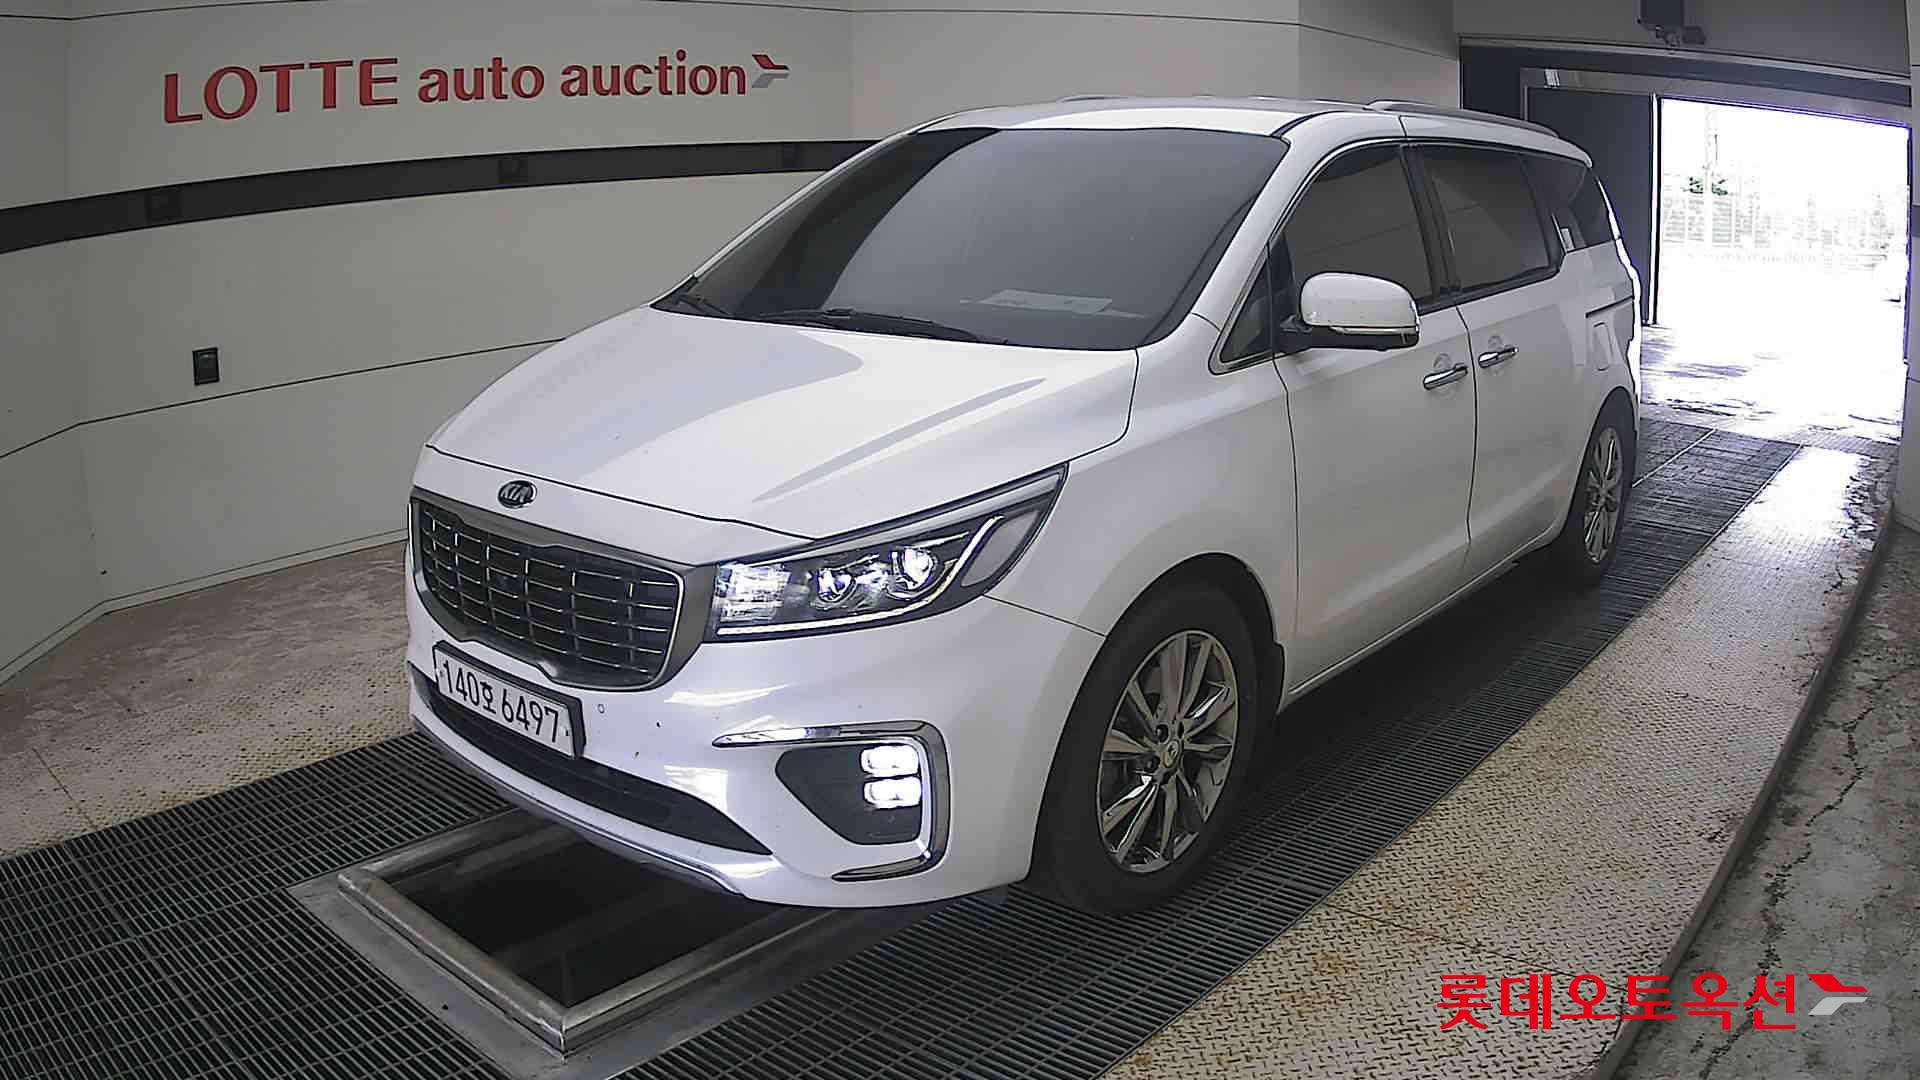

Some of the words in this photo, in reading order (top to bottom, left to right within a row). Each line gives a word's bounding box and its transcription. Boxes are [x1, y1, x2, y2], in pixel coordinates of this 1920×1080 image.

[164, 57, 399, 124] LOTTE
[417, 56, 545, 103] auto
[560, 49, 748, 98] auction
[499, 482, 533, 505] KIA
[443, 660, 497, 714] 140호
[501, 688, 559, 743] 6497
